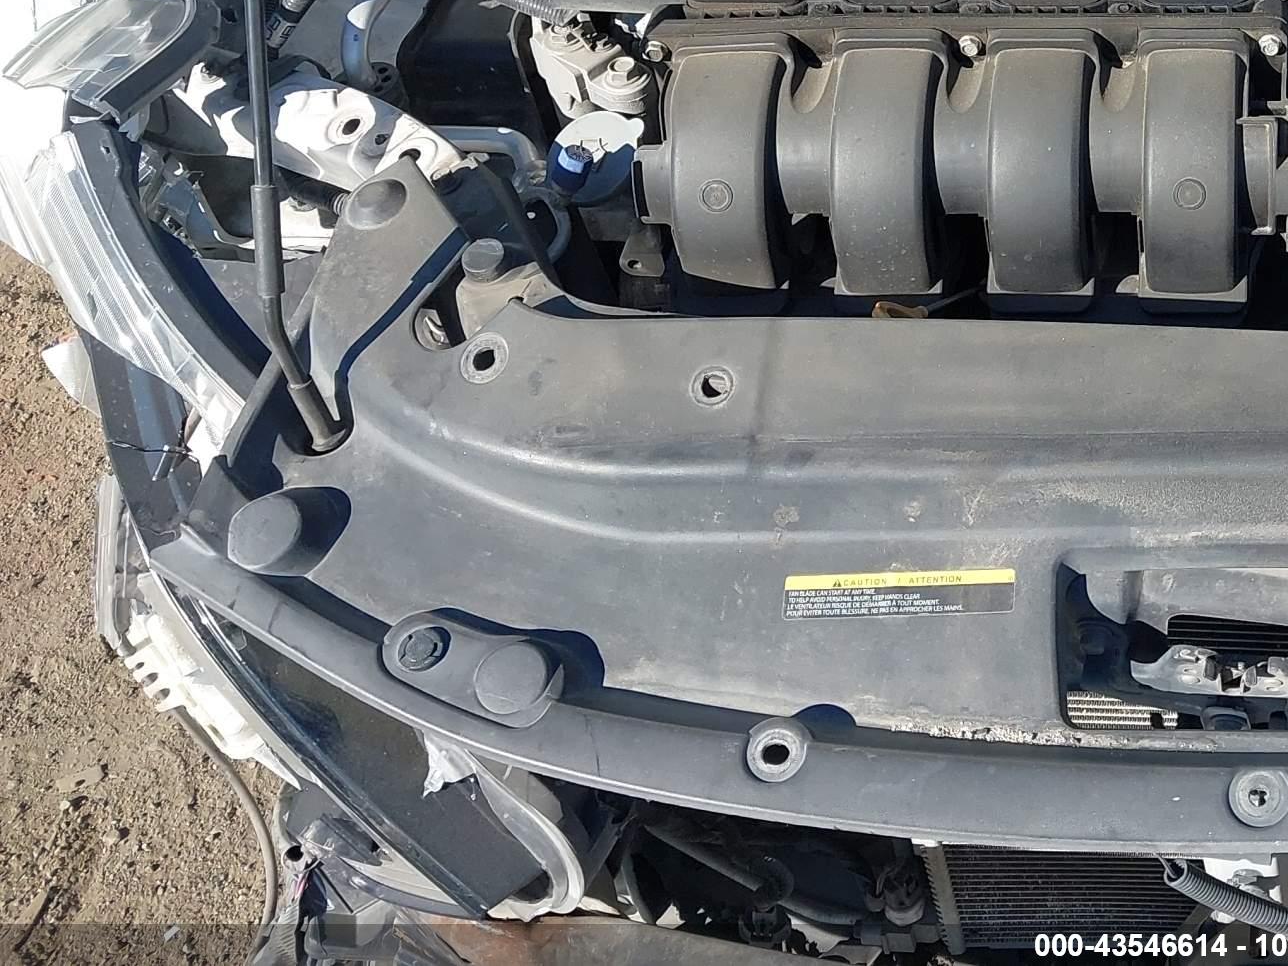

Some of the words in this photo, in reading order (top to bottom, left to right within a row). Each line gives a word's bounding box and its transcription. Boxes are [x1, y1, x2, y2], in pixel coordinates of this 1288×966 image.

[843, 578, 887, 587] CAUTION
[908, 575, 962, 584] ATTENTION
[826, 595, 854, 603] PERSONAL
[794, 602, 831, 610] VENTILATEUR
[831, 601, 852, 609] RISQUE
[786, 609, 803, 617] POUR
[822, 608, 841, 616] TOUTE
[870, 607, 879, 615] NE
[889, 606, 899, 614] EN
[898, 605, 933, 613] APPROCHER
